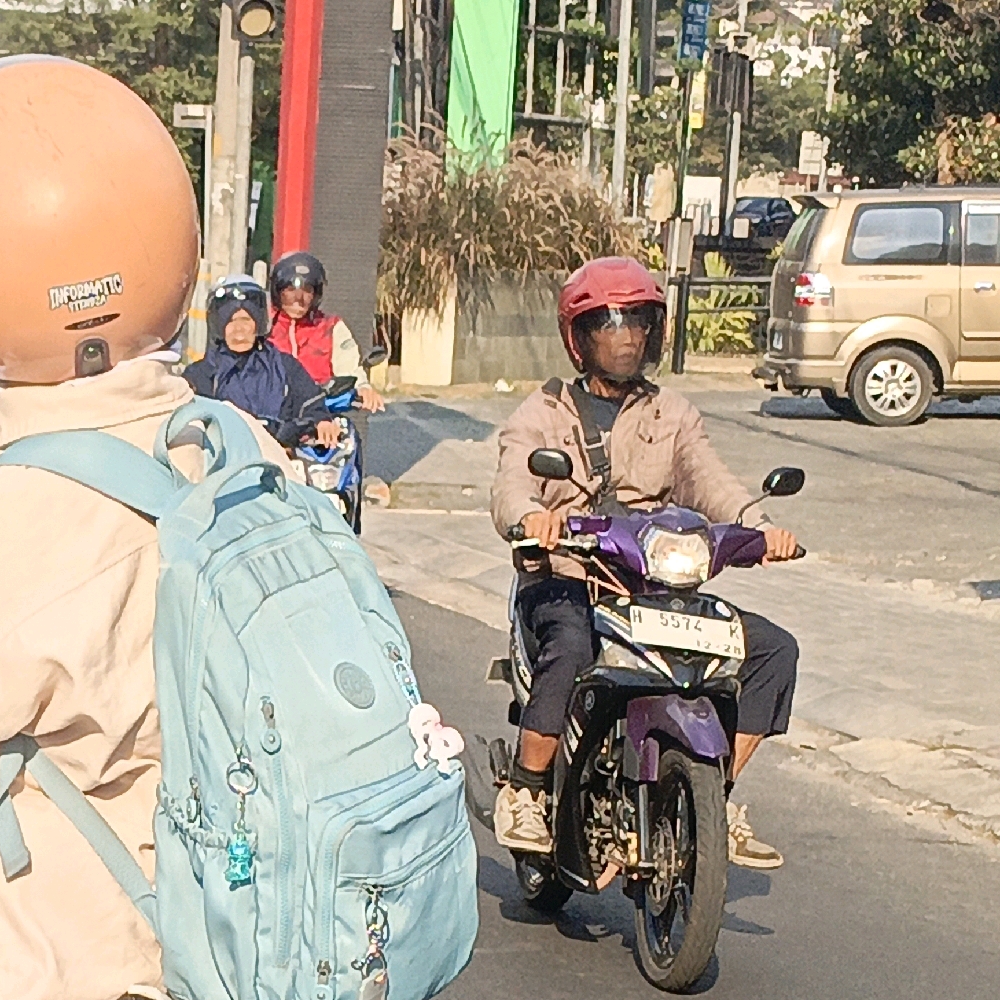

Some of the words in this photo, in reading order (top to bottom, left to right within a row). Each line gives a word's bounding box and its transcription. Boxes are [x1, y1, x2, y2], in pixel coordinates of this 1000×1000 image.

[48, 273, 123, 309] INFORMATIC
[633, 609, 642, 623] H
[659, 612, 702, 632] 5574
